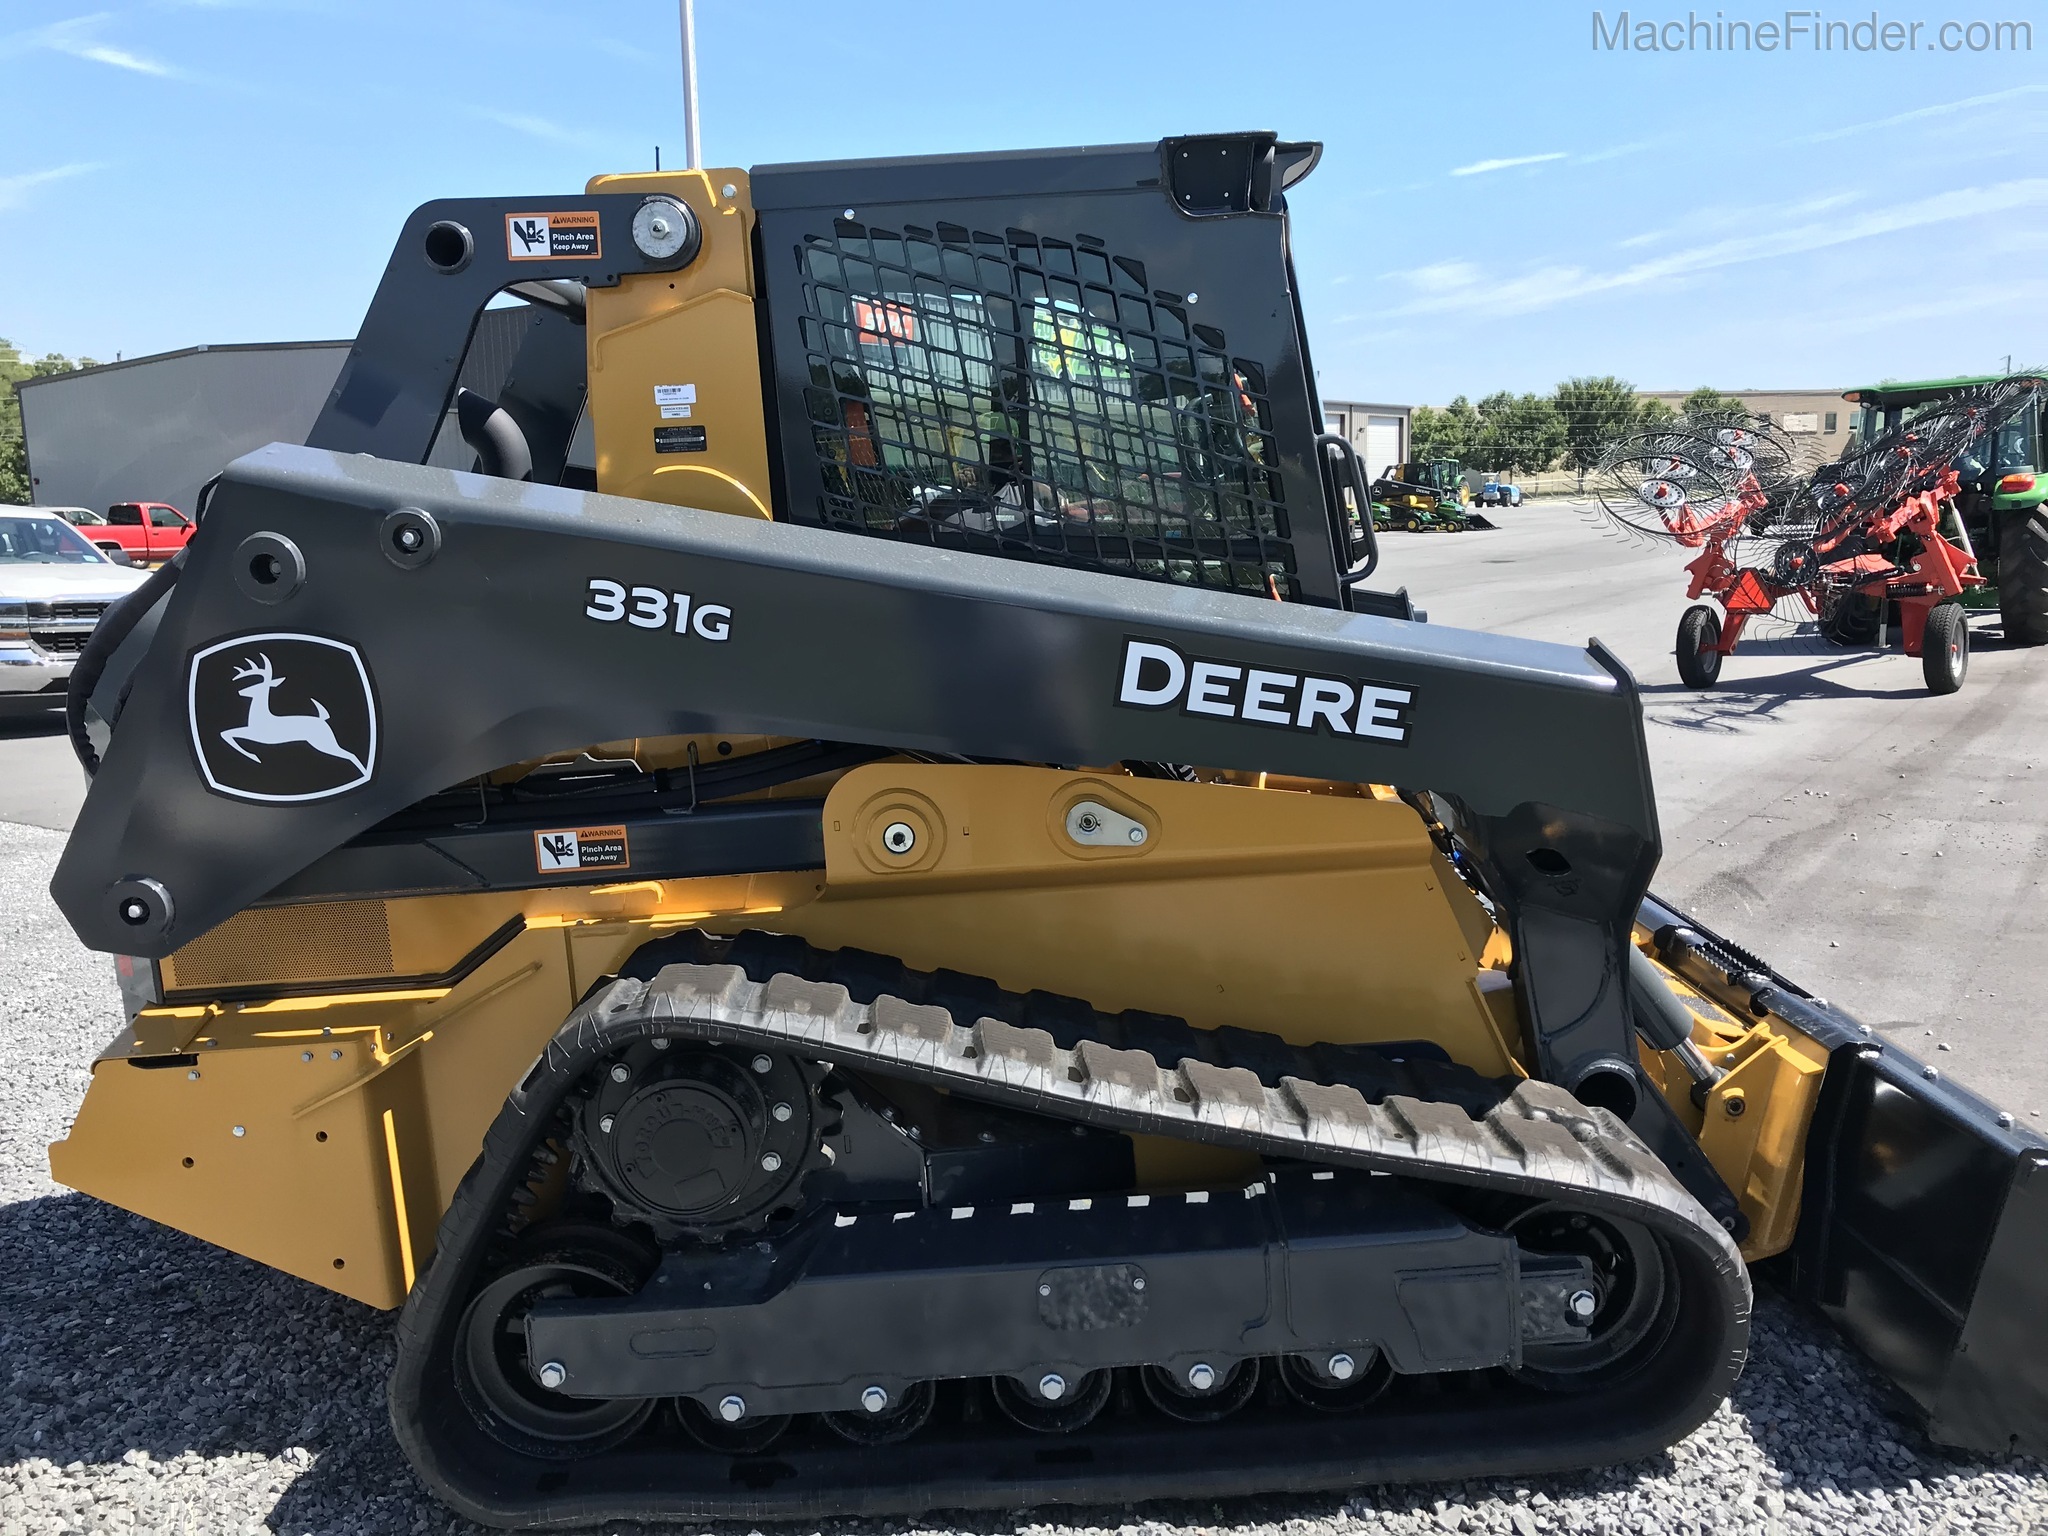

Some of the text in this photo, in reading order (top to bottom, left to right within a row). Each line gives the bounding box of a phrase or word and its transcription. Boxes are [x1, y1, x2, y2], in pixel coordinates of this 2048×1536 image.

[552, 232, 594, 241] Pinch Area
[553, 243, 589, 251] Keep Away
[864, 312, 910, 336] STHL
[586, 579, 732, 641] 331G
[1120, 641, 1412, 741] DEERE
[587, 829, 622, 837] WARNING
[581, 844, 622, 853] Pinch Area
